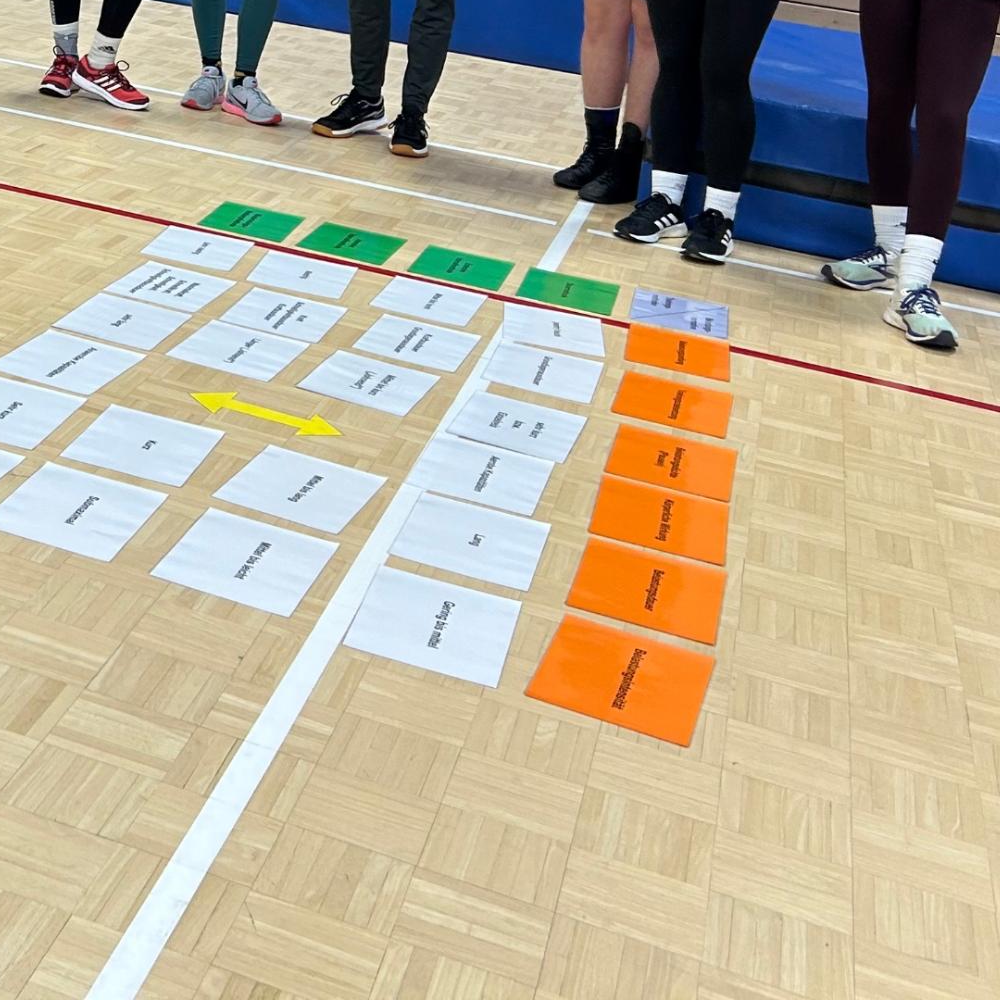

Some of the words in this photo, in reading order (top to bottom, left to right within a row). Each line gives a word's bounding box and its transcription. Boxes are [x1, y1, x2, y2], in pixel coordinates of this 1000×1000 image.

[142, 440, 156, 450] Kurz
[306, 475, 324, 487] Mittel
[287, 492, 306, 502] lang
[65, 496, 100, 525] Submaximal
[468, 533, 485, 547] Lang
[253, 542, 272, 557] Mittel
[246, 555, 260, 565] bis
[234, 564, 254, 580] leicht
[644, 569, 665, 611] Belastungsdauer
[435, 601, 455, 621] Gering
[434, 620, 448, 631] bis
[427, 631, 441, 649] mittel
[611, 648, 647, 710] Belastungsintensität
